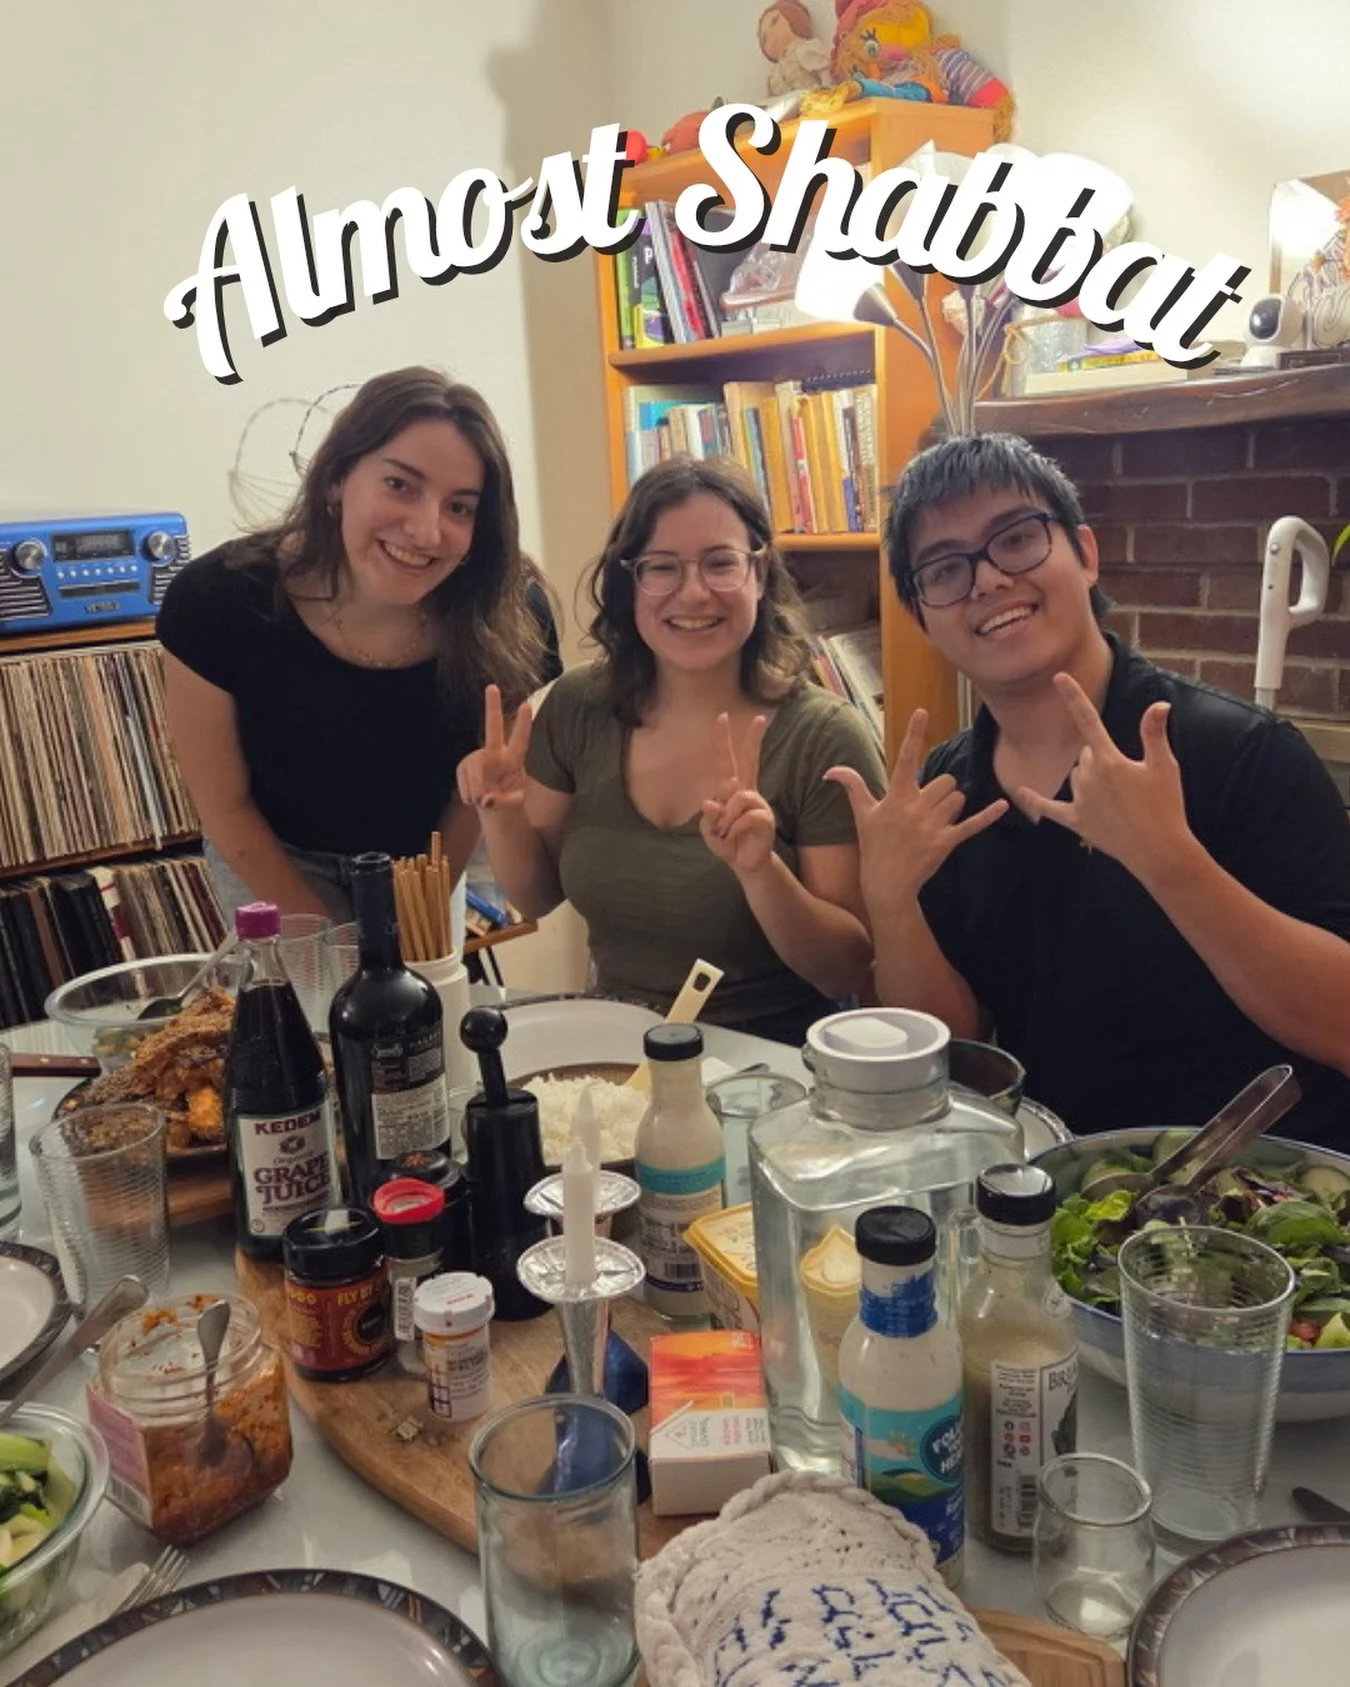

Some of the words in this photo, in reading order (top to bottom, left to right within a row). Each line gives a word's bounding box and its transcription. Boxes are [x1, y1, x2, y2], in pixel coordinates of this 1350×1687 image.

[255, 1111, 321, 1135] KEDEM
[253, 1150, 330, 1185] GRAPE
[255, 1172, 331, 1205] JUICE
